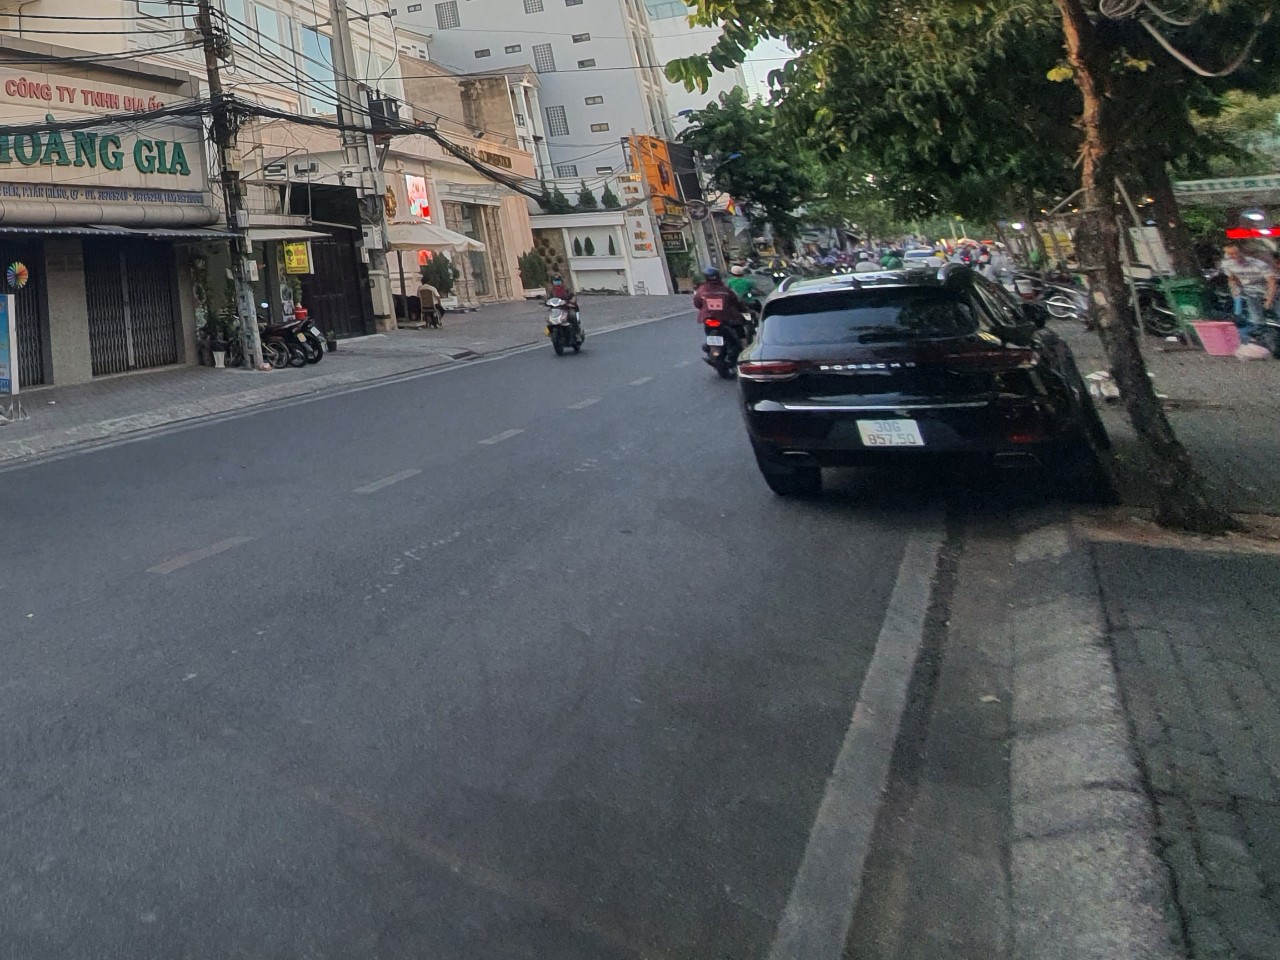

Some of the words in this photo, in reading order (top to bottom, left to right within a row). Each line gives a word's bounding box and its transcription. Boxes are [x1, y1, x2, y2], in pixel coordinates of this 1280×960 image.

[5, 77, 53, 102] CÔNG
[56, 85, 77, 104] TY
[81, 90, 120, 110] TNHH
[133, 139, 191, 176] GIA
[874, 421, 902, 433] 30G
